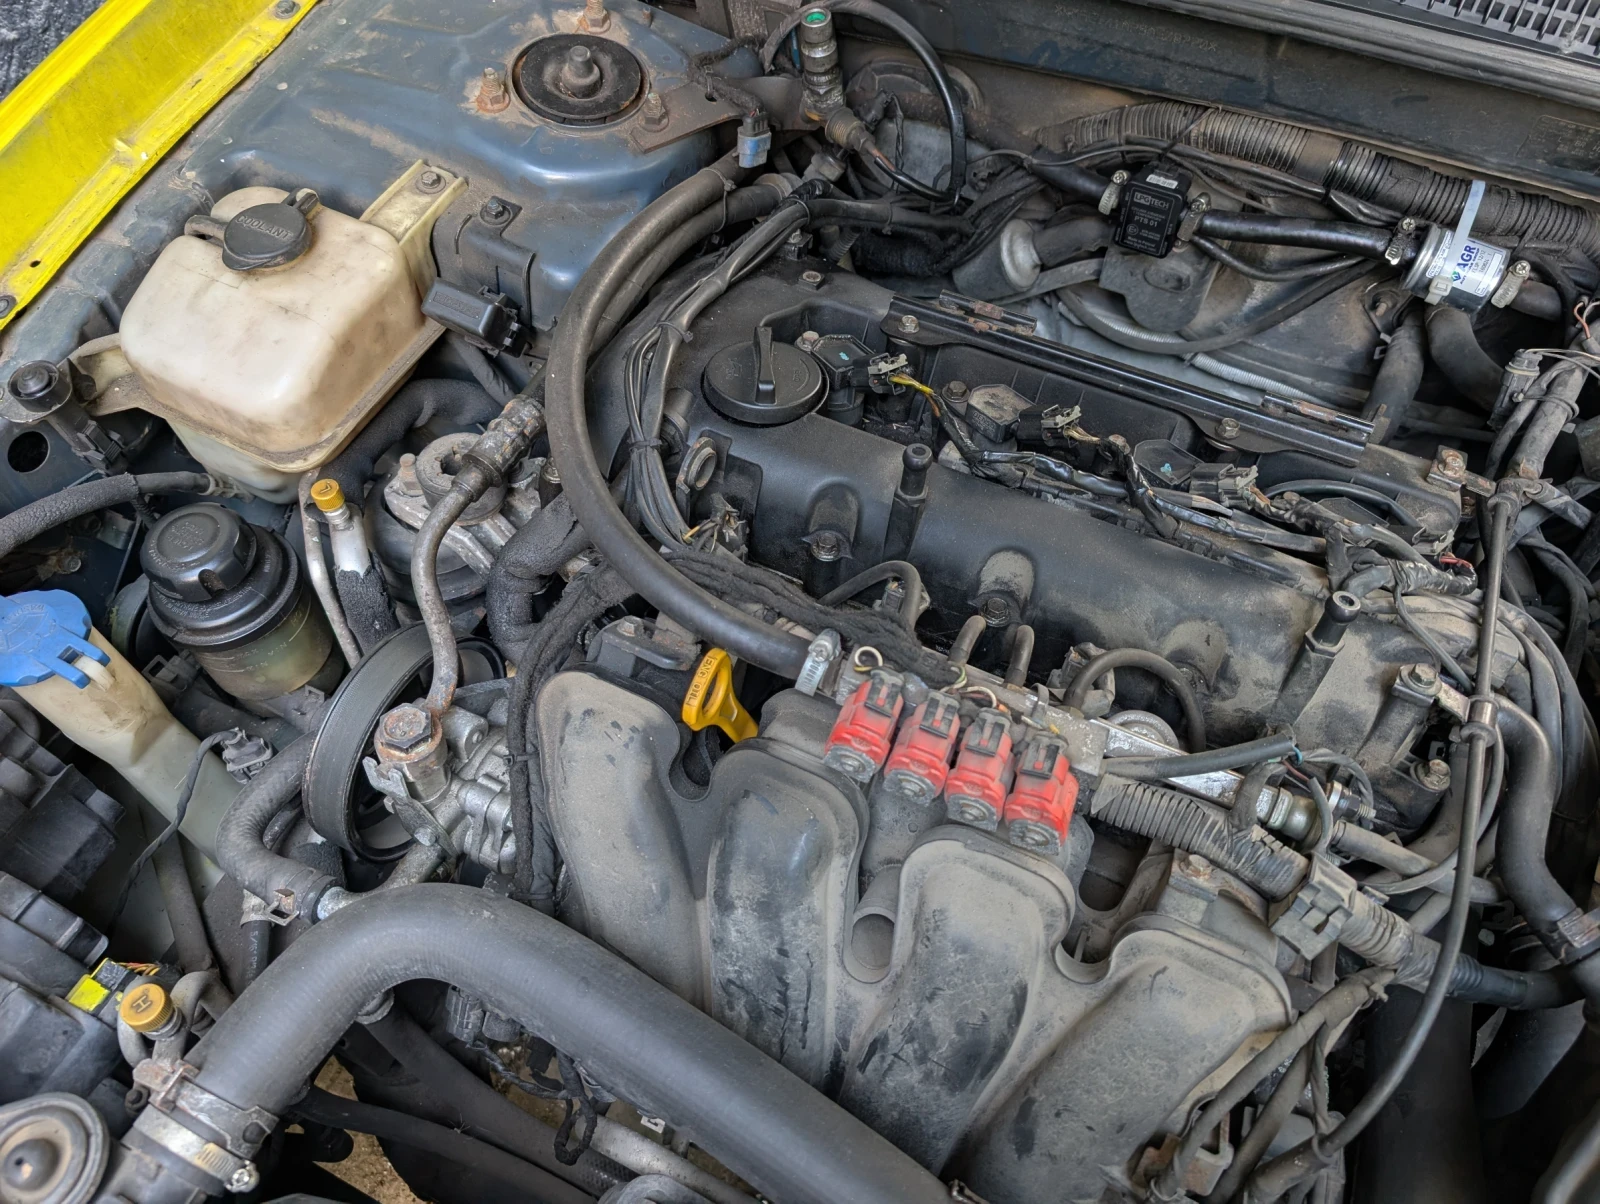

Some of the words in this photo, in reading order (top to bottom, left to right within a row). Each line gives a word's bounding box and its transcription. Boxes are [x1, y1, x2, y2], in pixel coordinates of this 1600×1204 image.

[236, 215, 292, 240] COOLANT
[1457, 245, 1476, 273] AGR
[686, 682, 702, 708] OIL
[132, 995, 152, 1013] H
